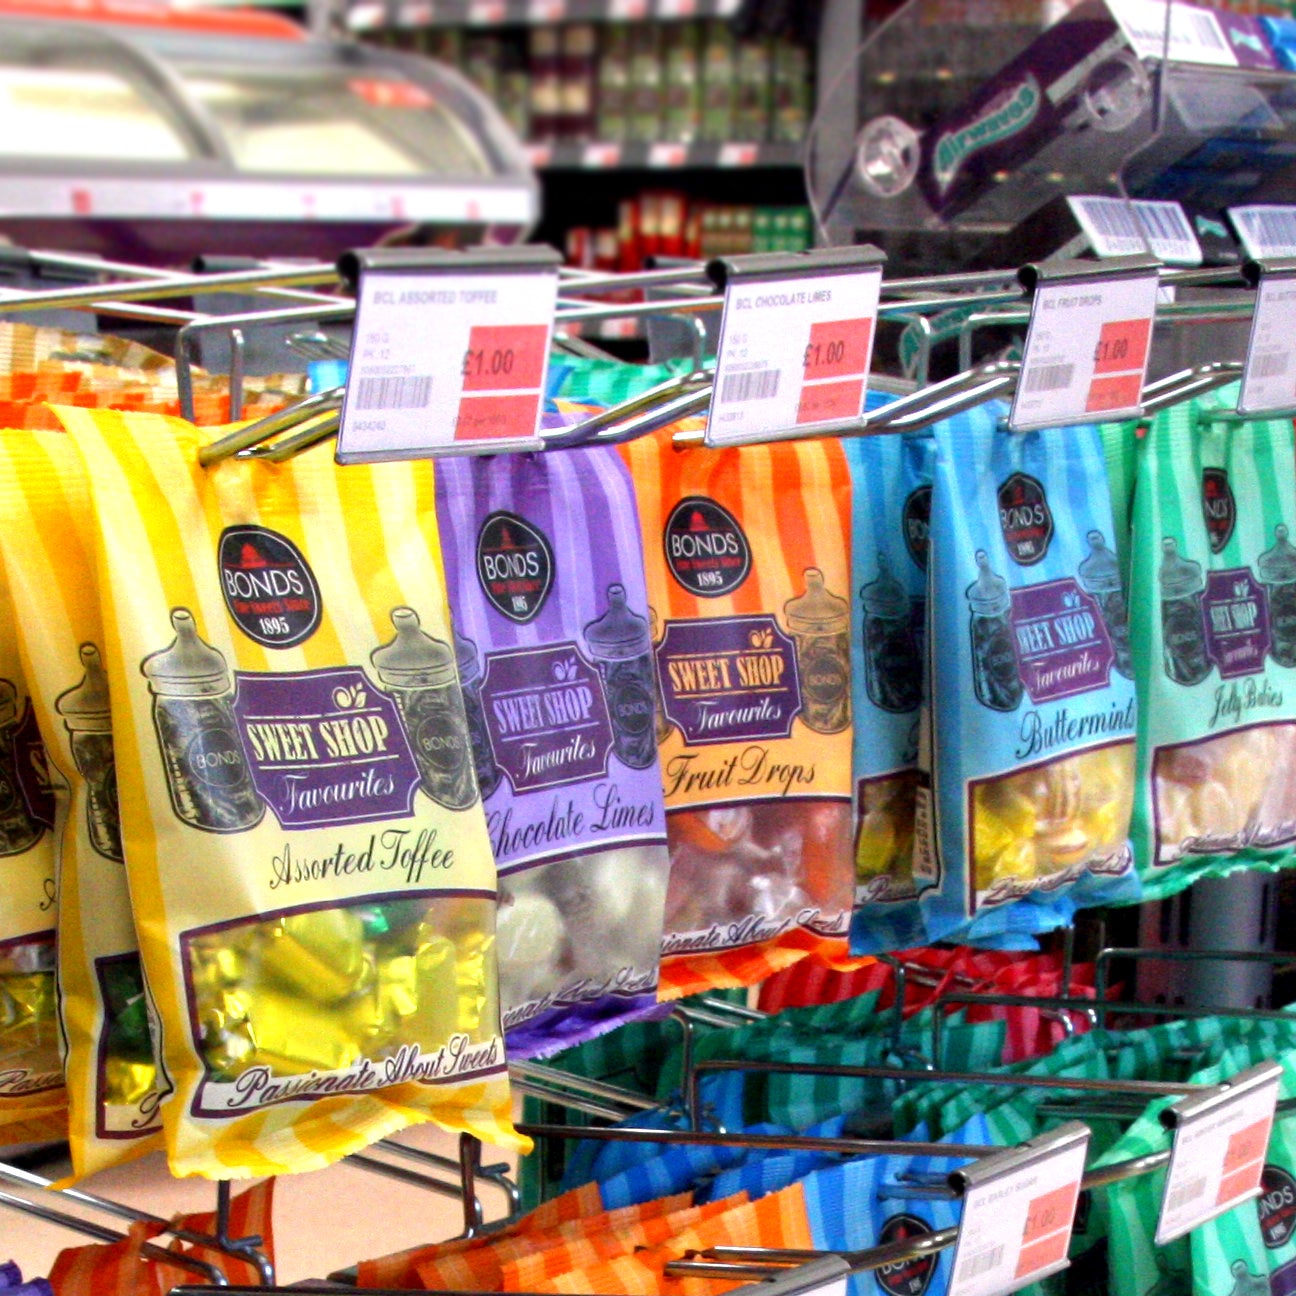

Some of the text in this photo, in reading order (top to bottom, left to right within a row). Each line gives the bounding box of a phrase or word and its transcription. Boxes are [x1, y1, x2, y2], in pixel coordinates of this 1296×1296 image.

[935, 82, 1038, 176] Airwaves
[399, 291, 456, 305] ASSORTED
[459, 289, 498, 304] TOFFEE
[755, 292, 806, 307] CHOCOLATE
[808, 290, 832, 304] LIMES
[461, 349, 514, 376] £1.00
[804, 340, 845, 367] £1.00
[1094, 338, 1129, 363] £1.00
[672, 532, 739, 559] BONDS
[224, 568, 305, 598] BONDS
[484, 551, 540, 580] BONDS
[697, 572, 723, 587] 1895
[259, 616, 290, 635] 1895
[1016, 612, 1095, 655] WEET SHOP
[668, 654, 785, 692] SWEET SHOP
[1030, 652, 1100, 692] Favourites
[493, 686, 594, 734] SWEET SHOP
[689, 698, 782, 734] Favourites
[246, 715, 390, 762] SWEET SHOP
[516, 733, 597, 780] Favourites
[196, 751, 242, 769] BONDS
[663, 745, 816, 798] Fruit Drops
[279, 768, 395, 815] Favourites
[589, 783, 655, 834] Limes
[269, 828, 455, 890] Assorted Toffee
[227, 1036, 499, 1107] Passionate About Sweets
